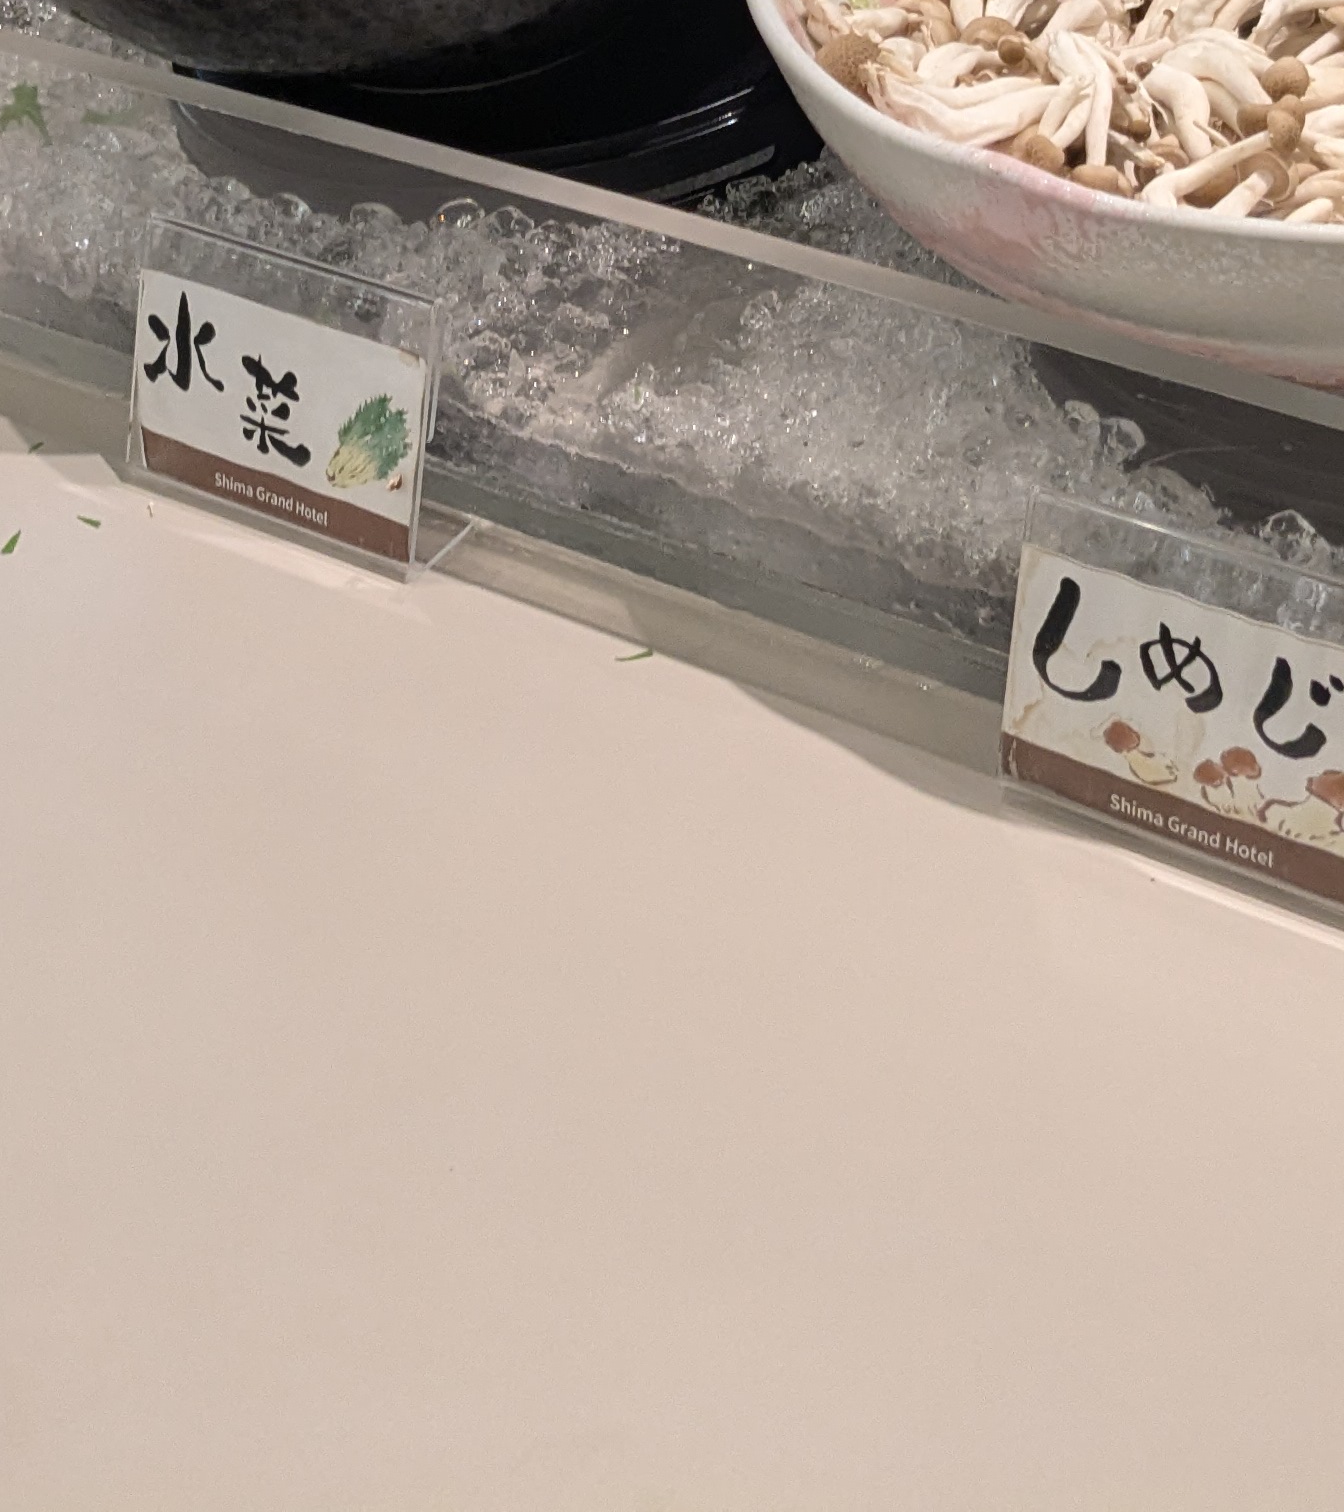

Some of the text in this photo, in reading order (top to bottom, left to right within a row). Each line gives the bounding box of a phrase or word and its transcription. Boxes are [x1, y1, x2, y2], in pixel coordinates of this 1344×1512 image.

[143, 290, 312, 467] 水菜
[214, 471, 329, 528] Shima Grand Hotel
[1032, 575, 1344, 760] しめじ
[1109, 793, 1274, 869] Shima Grand Hotel
